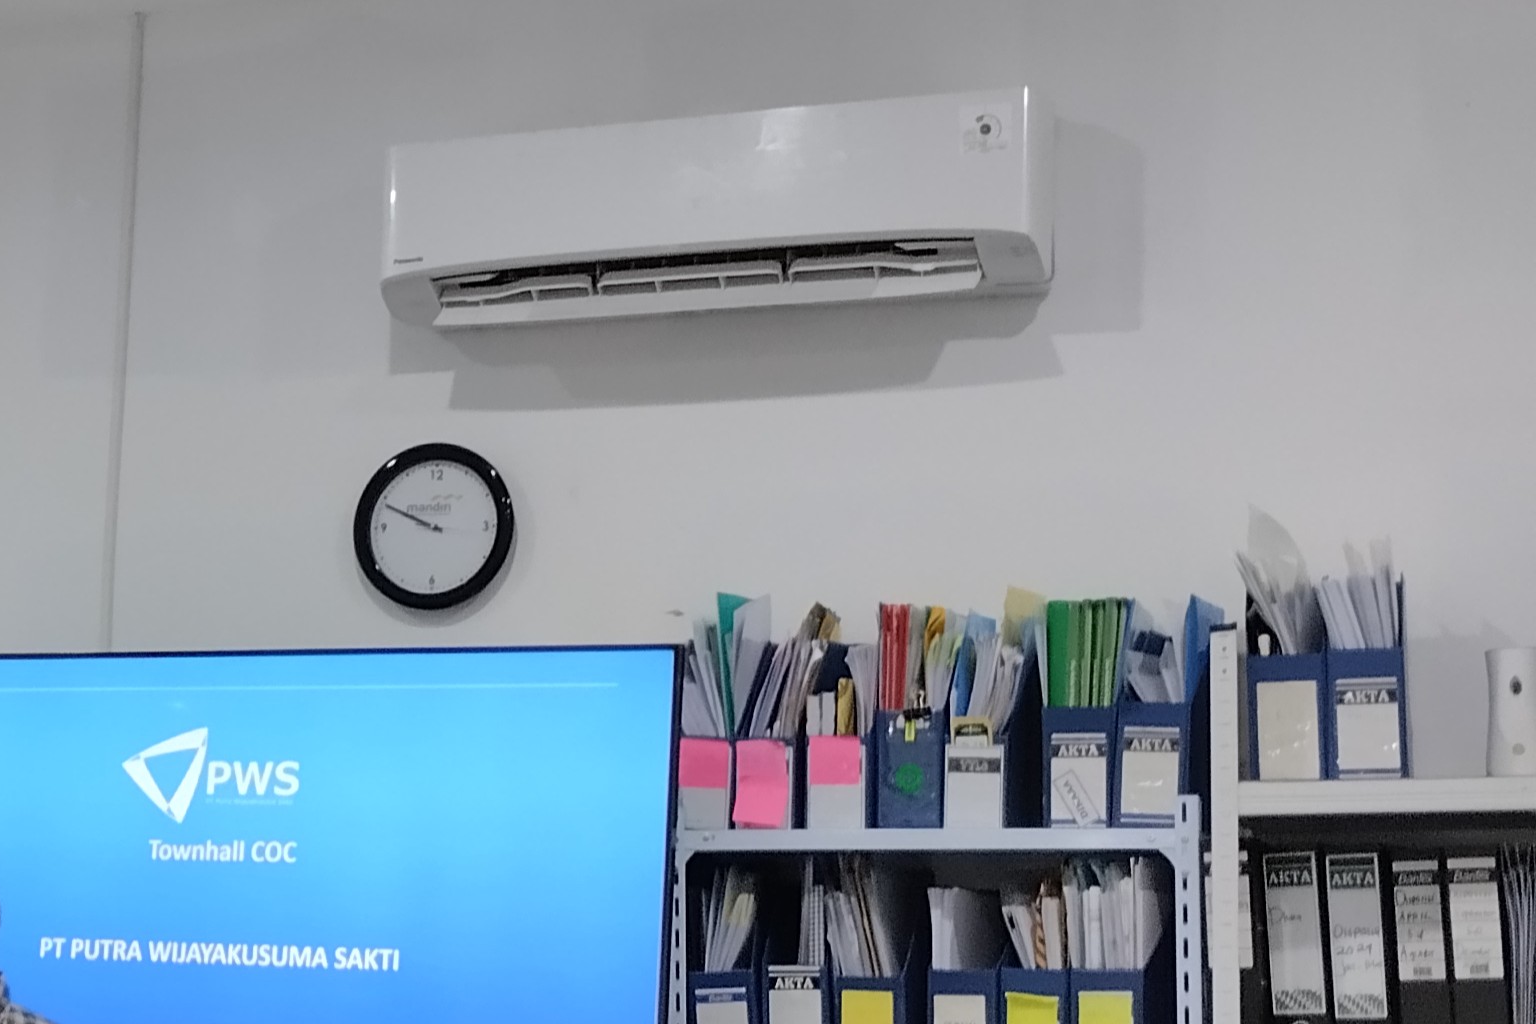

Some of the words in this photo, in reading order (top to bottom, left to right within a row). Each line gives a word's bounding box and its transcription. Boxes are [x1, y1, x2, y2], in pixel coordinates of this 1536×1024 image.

[430, 469, 444, 481] 12
[406, 502, 452, 514] mandiri
[1344, 689, 1390, 704] AKTA
[1057, 744, 1100, 758] AKTA
[1129, 738, 1172, 752] AKTA
[206, 760, 300, 797] PWS
[148, 838, 246, 863] Townhall
[250, 840, 299, 864] COC
[1268, 869, 1312, 886] AKTA
[1331, 871, 1375, 887] AKTA
[39, 936, 66, 960] PT
[69, 938, 143, 963] PUTRA
[148, 940, 329, 970] WIJAYAKUSUMA
[333, 946, 400, 972] SAKTI
[774, 977, 814, 990] AKTA
